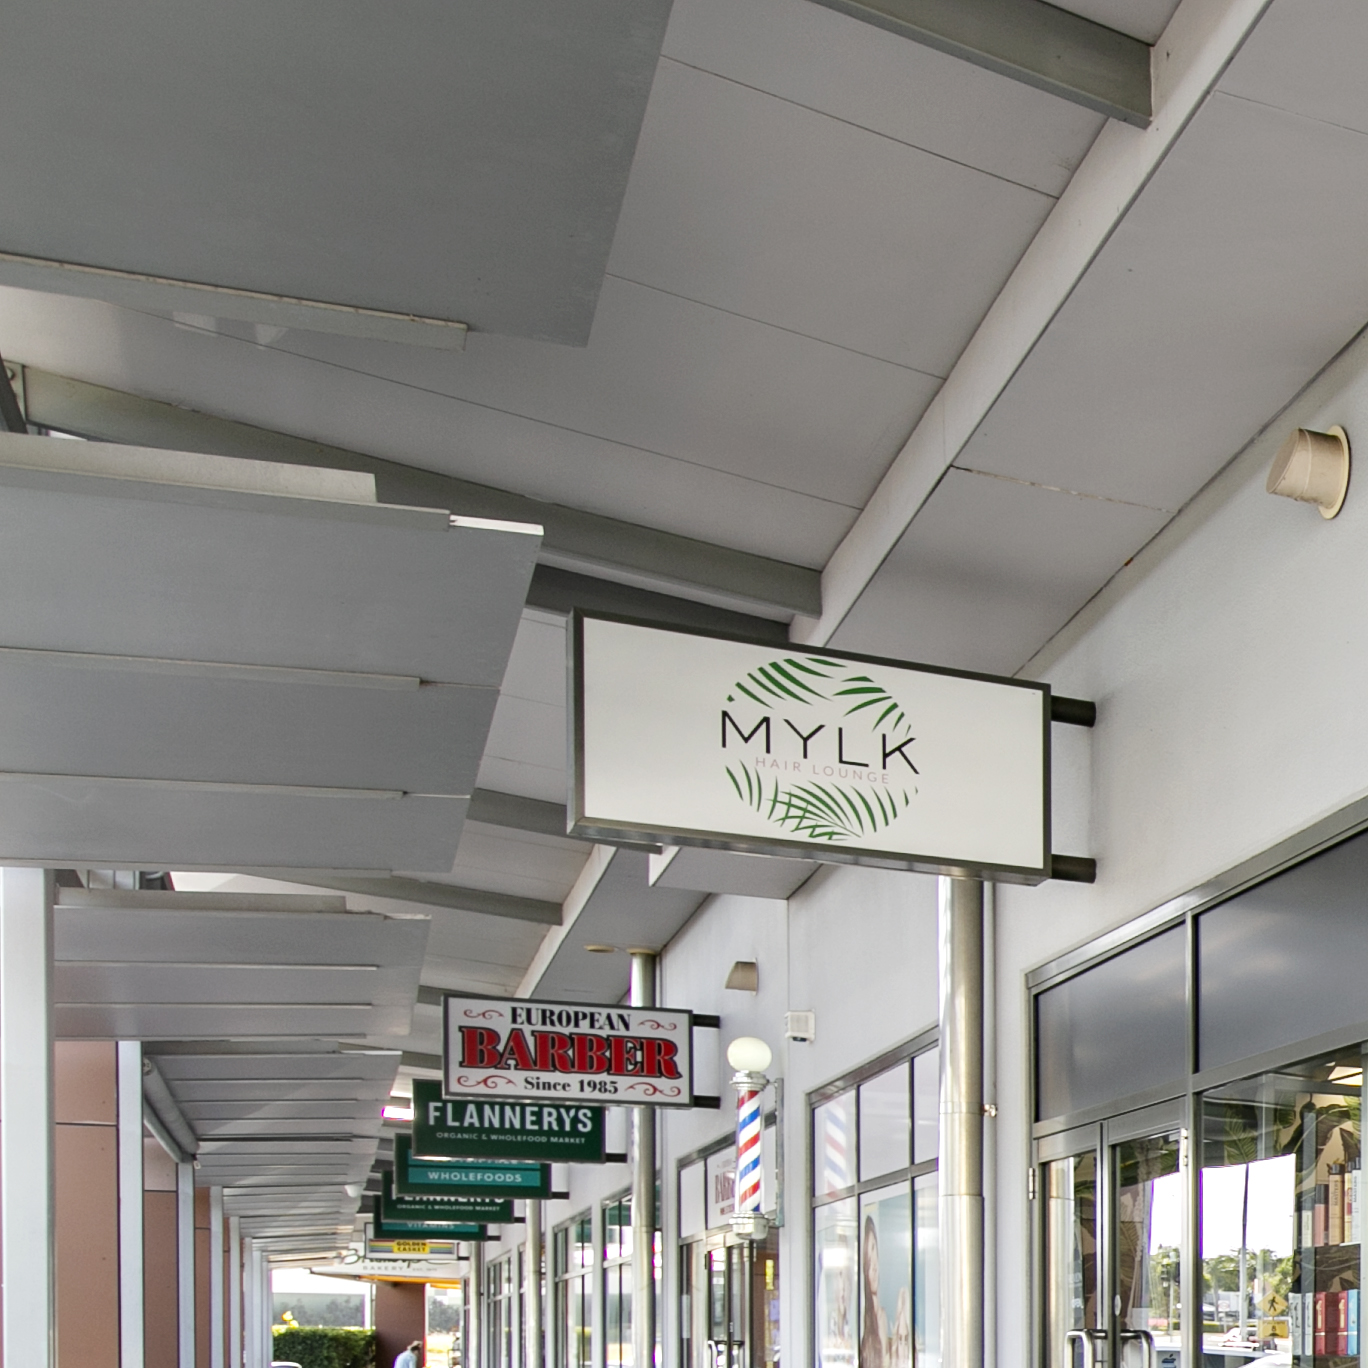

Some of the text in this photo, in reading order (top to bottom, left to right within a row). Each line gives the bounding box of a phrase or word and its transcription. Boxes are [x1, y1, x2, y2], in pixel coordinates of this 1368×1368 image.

[721, 710, 920, 774] MYLK
[755, 756, 890, 785] HAIR LOUNGE
[510, 1006, 631, 1032] EUROPEAN
[459, 1026, 682, 1079] BARBER
[523, 1076, 619, 1095] Since 1985
[436, 1131, 586, 1144] ORGANIC & WHOLEFOOD MARKET
[427, 1171, 522, 1182] WHOLEFOODS
[407, 1222, 455, 1230] VITAMINS
